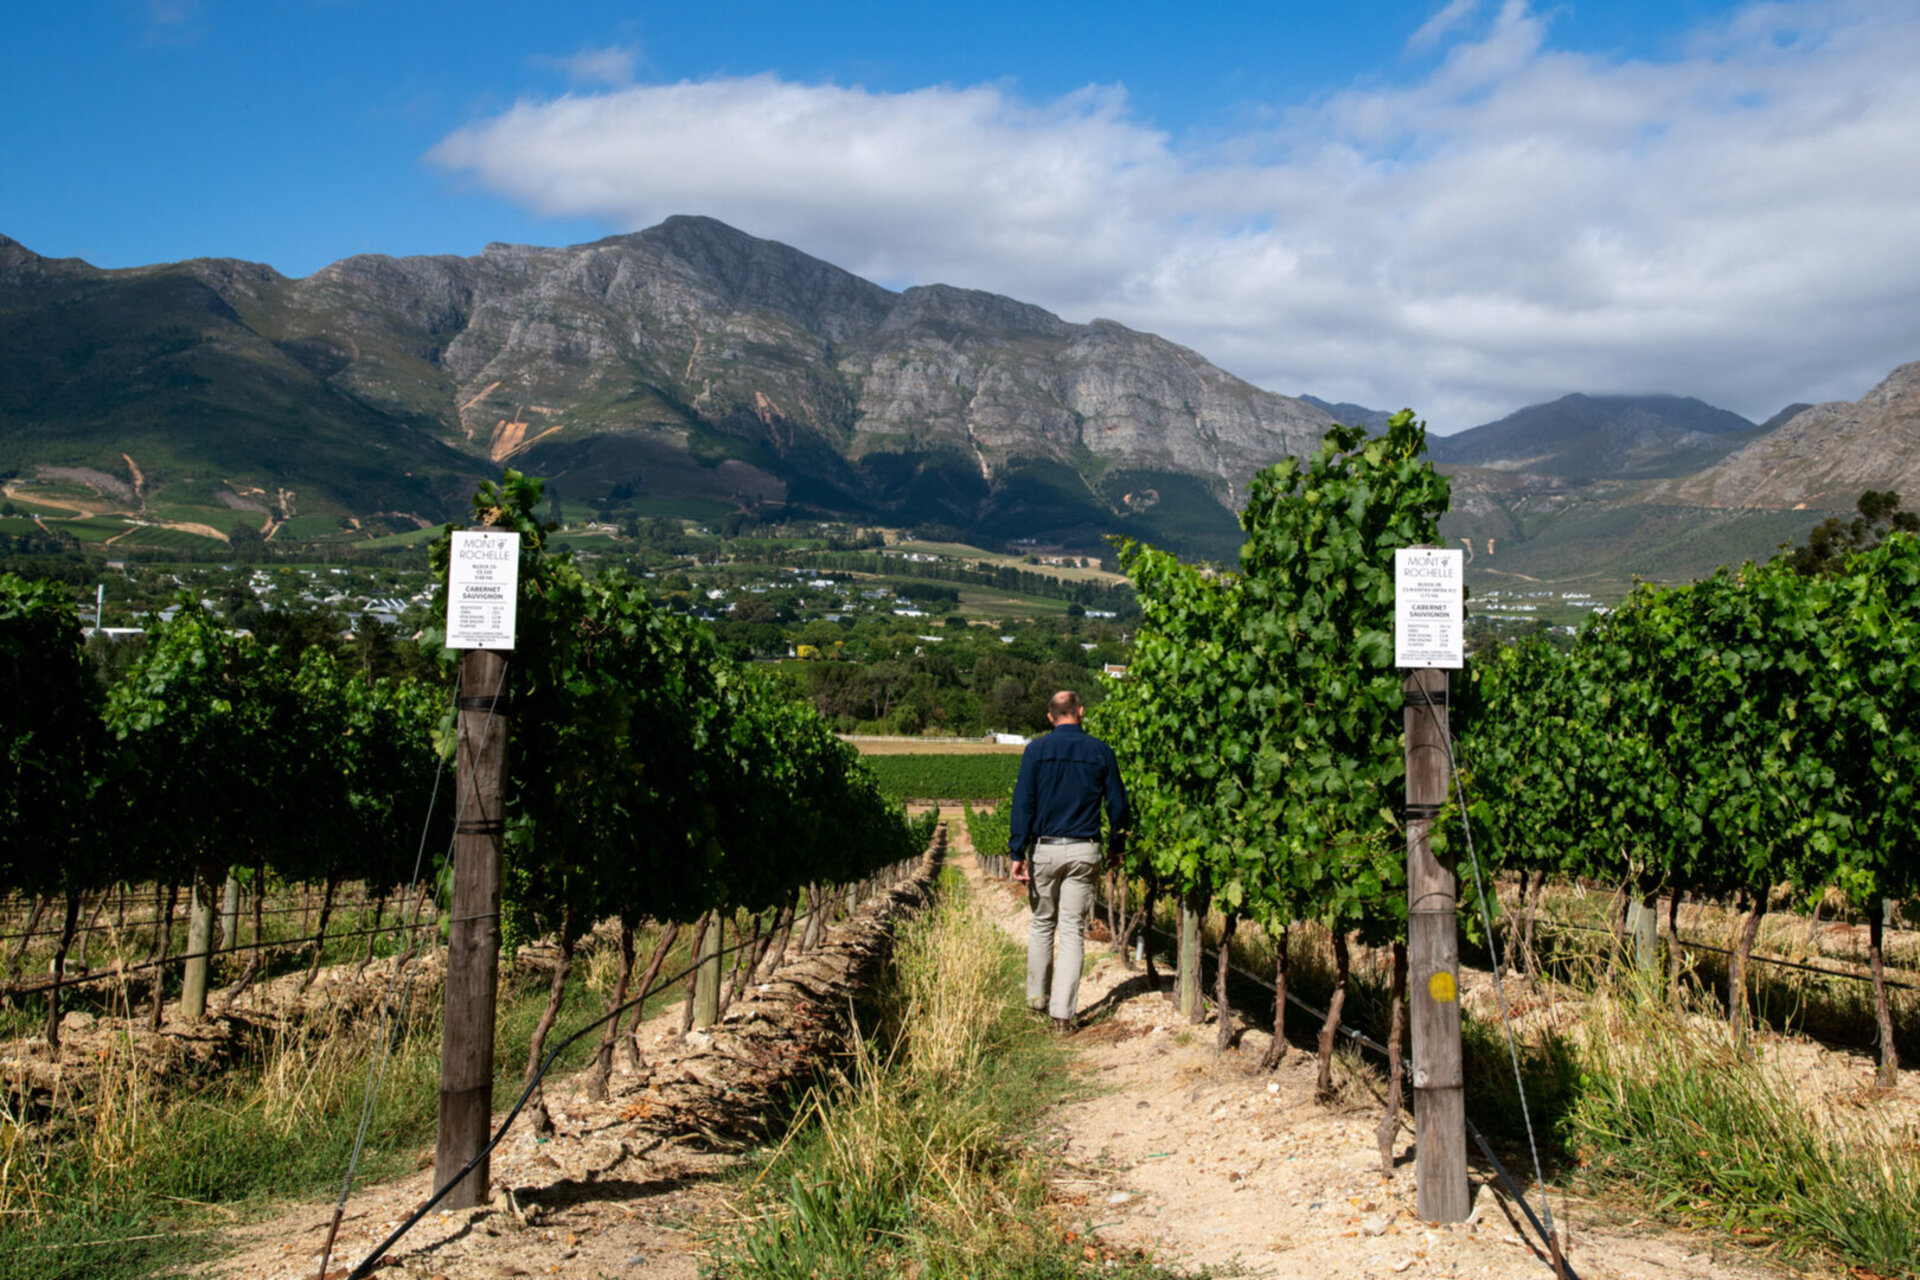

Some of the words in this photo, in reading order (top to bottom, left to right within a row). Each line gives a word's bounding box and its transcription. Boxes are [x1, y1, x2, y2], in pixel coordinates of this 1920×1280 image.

[463, 539, 496, 549] MONT
[459, 550, 510, 561] ROCHELLE
[1407, 556, 1439, 566] MONT
[1403, 568, 1454, 578] ROCHELLE
